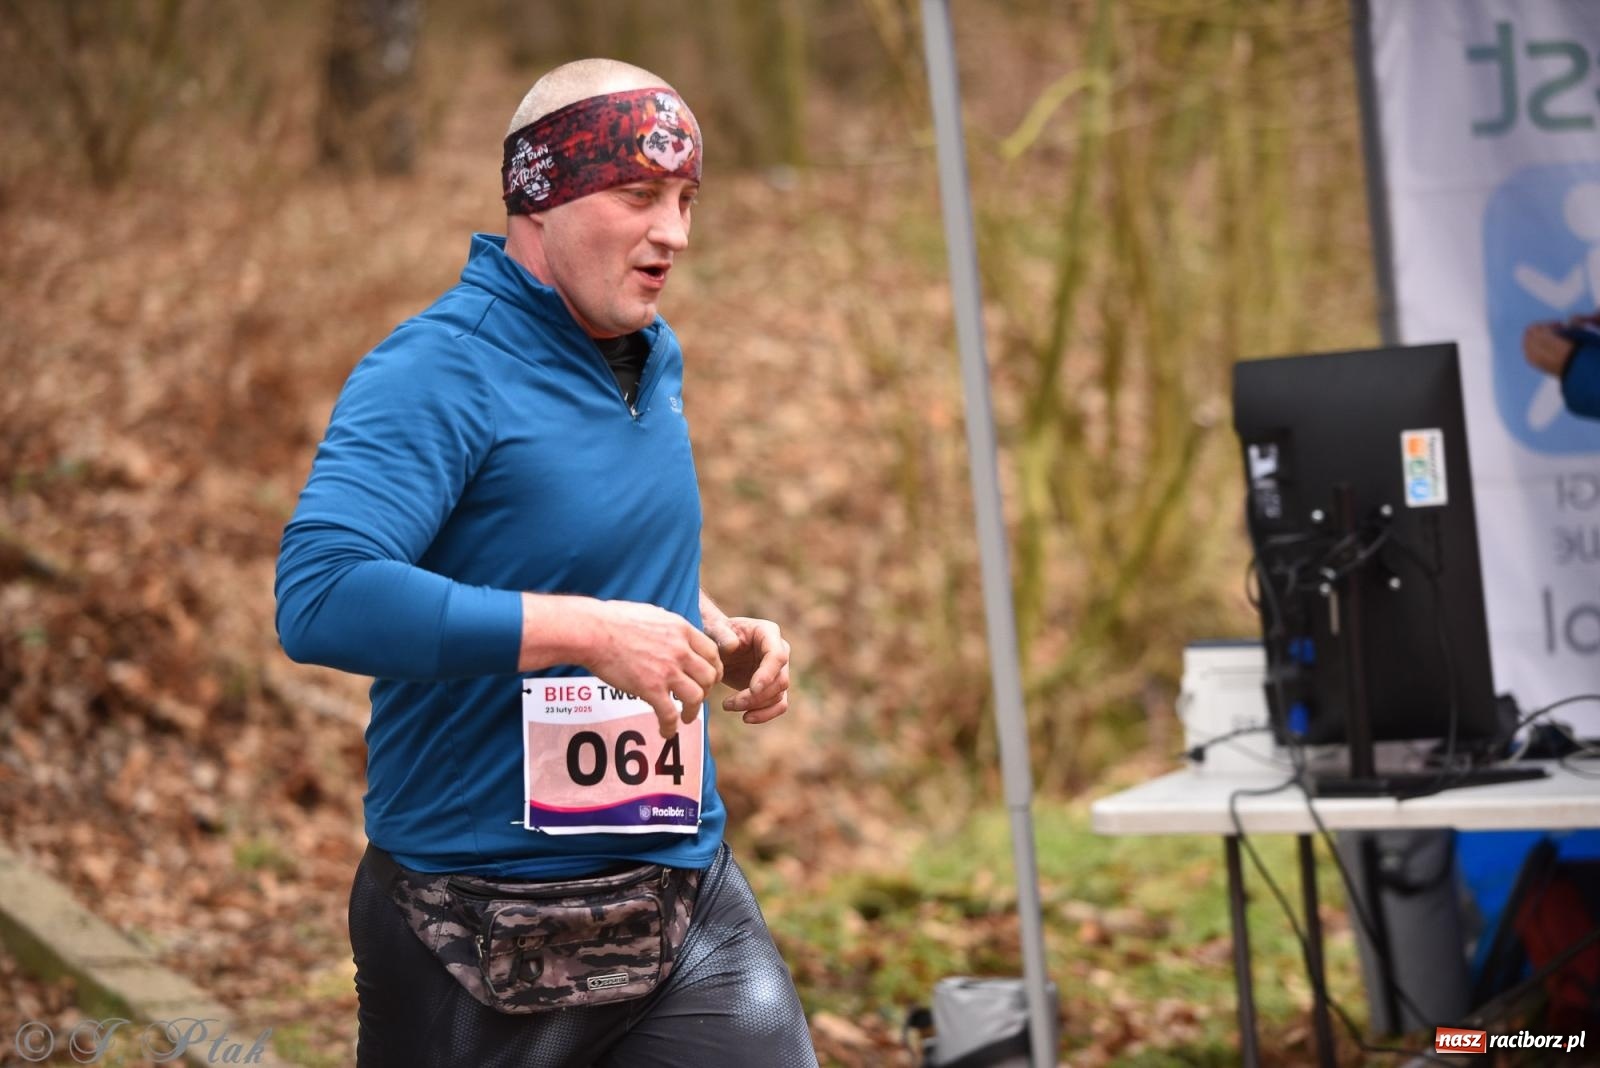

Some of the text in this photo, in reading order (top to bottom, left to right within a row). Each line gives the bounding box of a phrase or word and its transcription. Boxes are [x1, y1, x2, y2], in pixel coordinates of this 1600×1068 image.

[527, 143, 548, 162] RUN
[545, 686, 592, 702] BIEG
[556, 706, 573, 715] luty
[566, 730, 685, 786] 064
